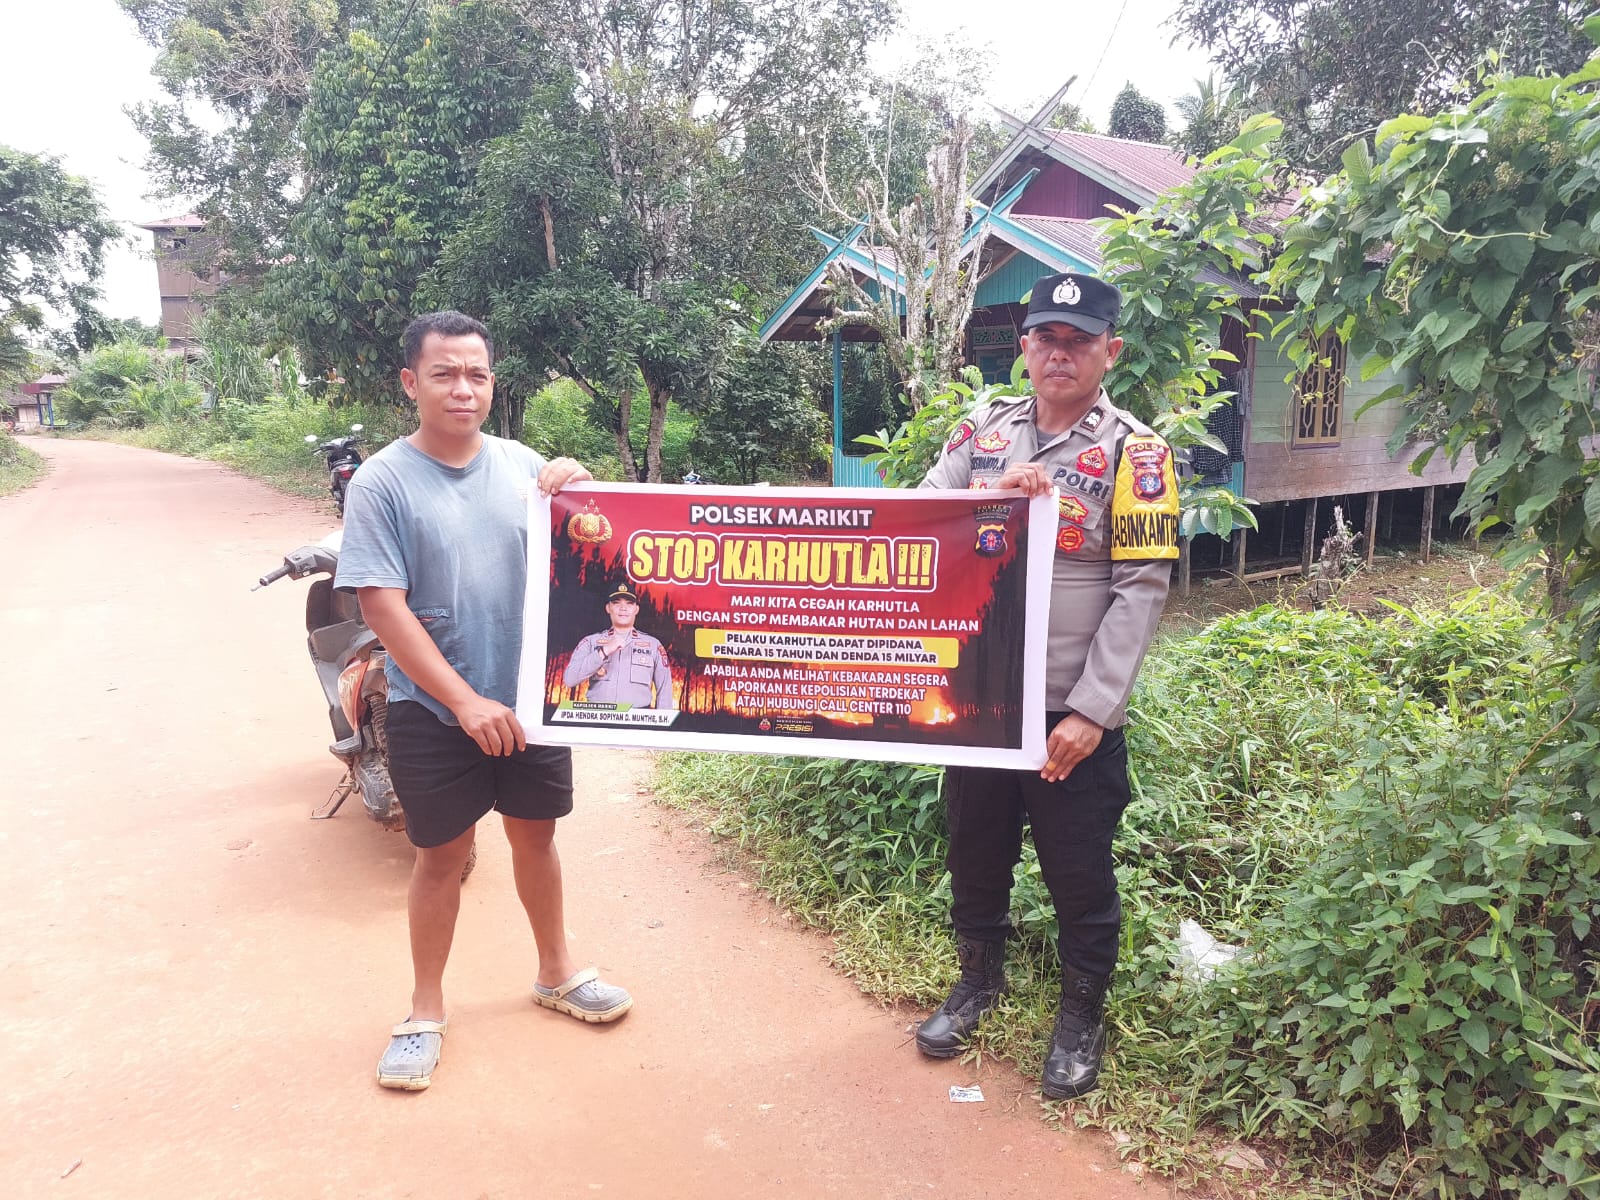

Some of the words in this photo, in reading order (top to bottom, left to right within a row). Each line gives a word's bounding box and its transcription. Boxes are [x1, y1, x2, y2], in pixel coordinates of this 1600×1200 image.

[1130, 442, 1164, 453] POLDA
[1053, 467, 1110, 499] POLRI
[691, 505, 773, 525] POLSEK
[777, 508, 873, 527] MARIKIT
[632, 536, 716, 579] STOP
[722, 539, 889, 585] KARHUTLA
[730, 595, 765, 607] MARI
[768, 597, 797, 608] KITA
[800, 598, 845, 611] CEGAH
[848, 600, 920, 613] KARHUTLA
[677, 610, 730, 623] DENGAN
[733, 612, 767, 624] STOP
[769, 614, 846, 628] MEMBAKAR
[848, 617, 895, 629] HUTAN
[898, 619, 928, 630] DAN
[931, 619, 979, 632] LAHAN
[727, 633, 767, 644] PELAKU
[769, 635, 826, 647] KARHUTLA
[828, 638, 865, 648] DAPAT
[867, 639, 922, 649] DIPIDANA
[714, 645, 762, 657] PENJARA
[764, 648, 774, 657] 15
[776, 649, 813, 660] TAHUN
[815, 651, 839, 660] DAN
[841, 651, 879, 661] DENDA
[882, 652, 892, 662] 15
[894, 653, 937, 663] MILYAR
[703, 664, 748, 678] APABILA
[750, 667, 781, 679] ANDA
[783, 669, 831, 682] MELIHAT
[832, 671, 901, 685] KEBAKARAN
[903, 673, 949, 686] SEGERA
[724, 680, 783, 695] LAPORKAN
[785, 683, 798, 695] KE
[800, 684, 866, 698] KEPOLISIAN
[868, 686, 926, 700] TERDEKAT
[736, 696, 764, 708] ATAU
[767, 698, 817, 710] HUBUNGI
[819, 699, 847, 711] CALL
[849, 701, 893, 713] CENTER
[895, 703, 912, 715] 110
[575, 711, 598, 720] HENDRA
[600, 713, 624, 721] SOPIYAN
[775, 723, 814, 732] PRESISI
